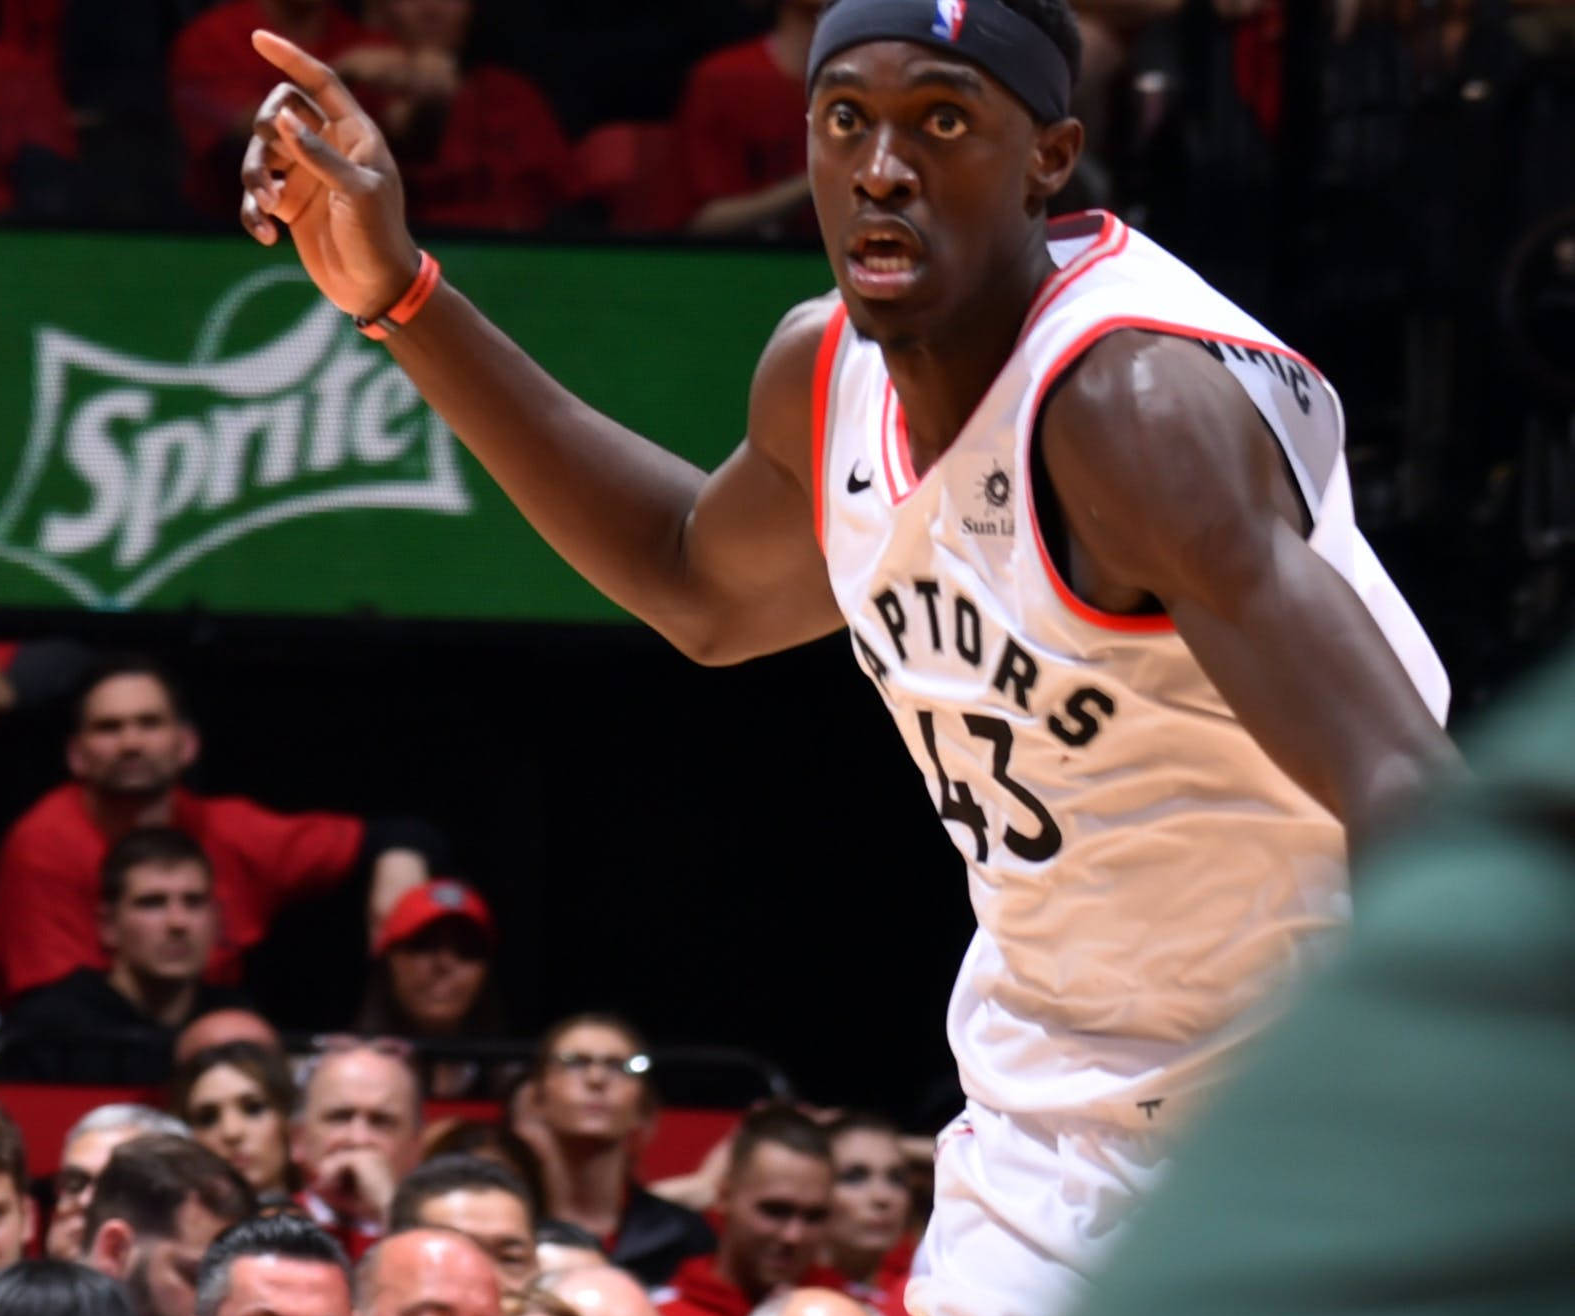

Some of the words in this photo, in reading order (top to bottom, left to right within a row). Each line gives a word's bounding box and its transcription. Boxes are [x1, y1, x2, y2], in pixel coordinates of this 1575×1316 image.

[38, 335, 422, 567] Sprite
[961, 516, 997, 536] Sun
[916, 710, 1063, 864] 43
